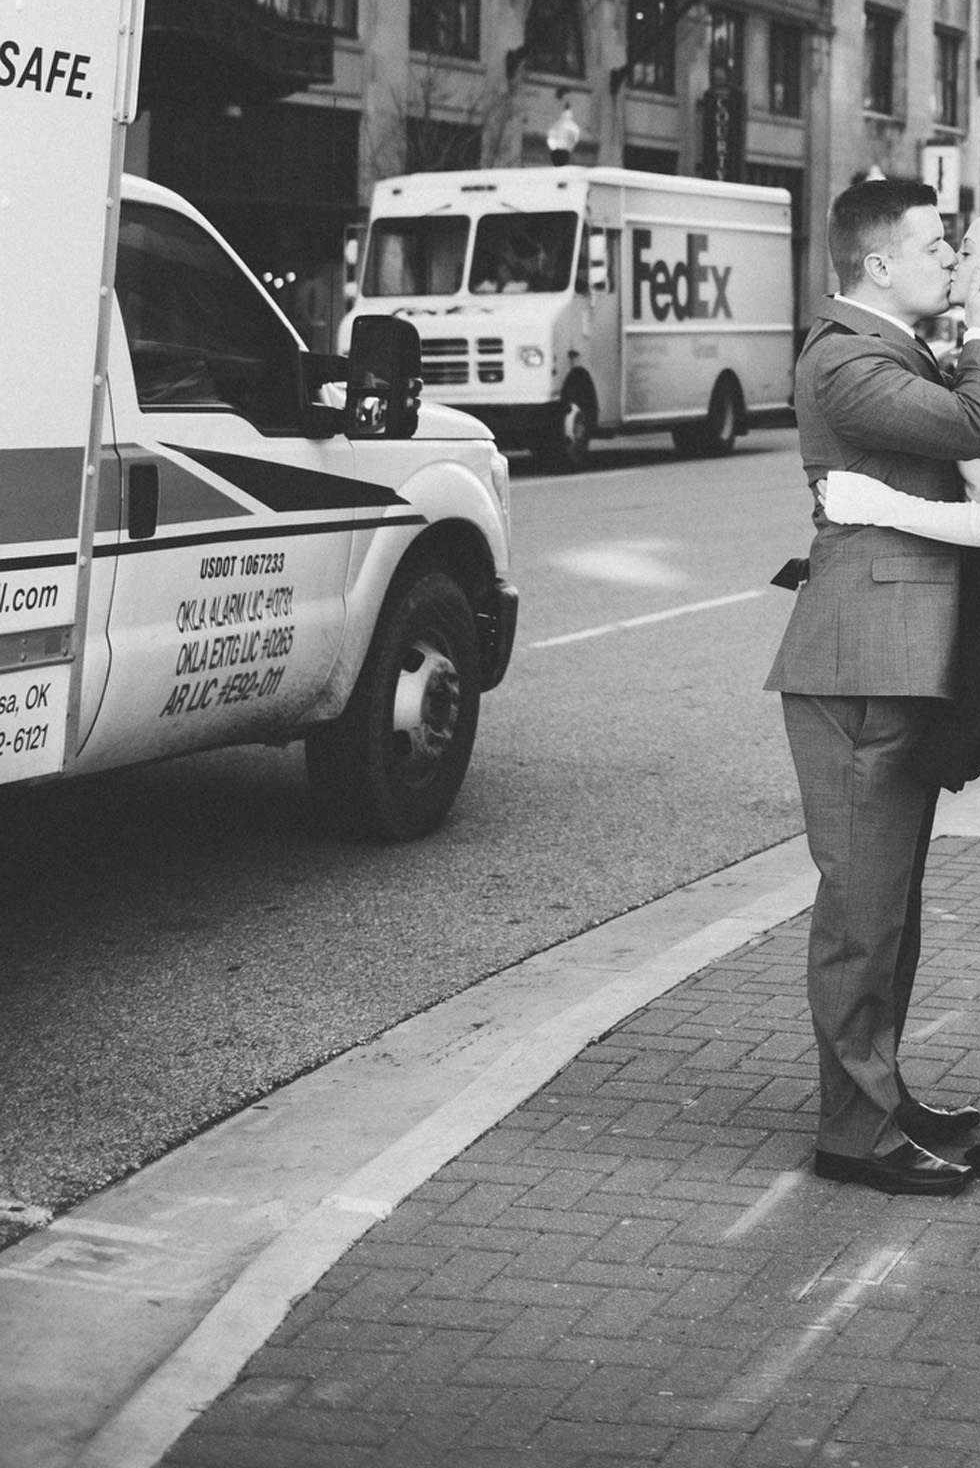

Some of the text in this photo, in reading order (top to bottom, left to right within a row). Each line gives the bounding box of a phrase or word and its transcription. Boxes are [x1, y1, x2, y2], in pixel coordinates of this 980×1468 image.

[0, 40, 93, 100] SAFE.
[631, 227, 734, 323] FedEx
[200, 552, 286, 580] USDOT 1067233
[176, 585, 295, 633] OKLA ALARM LIC #0731
[175, 625, 295, 677] OKLA EXTG LIC #0265
[25, 682, 52, 710] OK
[159, 682, 190, 718] AR
[186, 677, 219, 712] LIC
